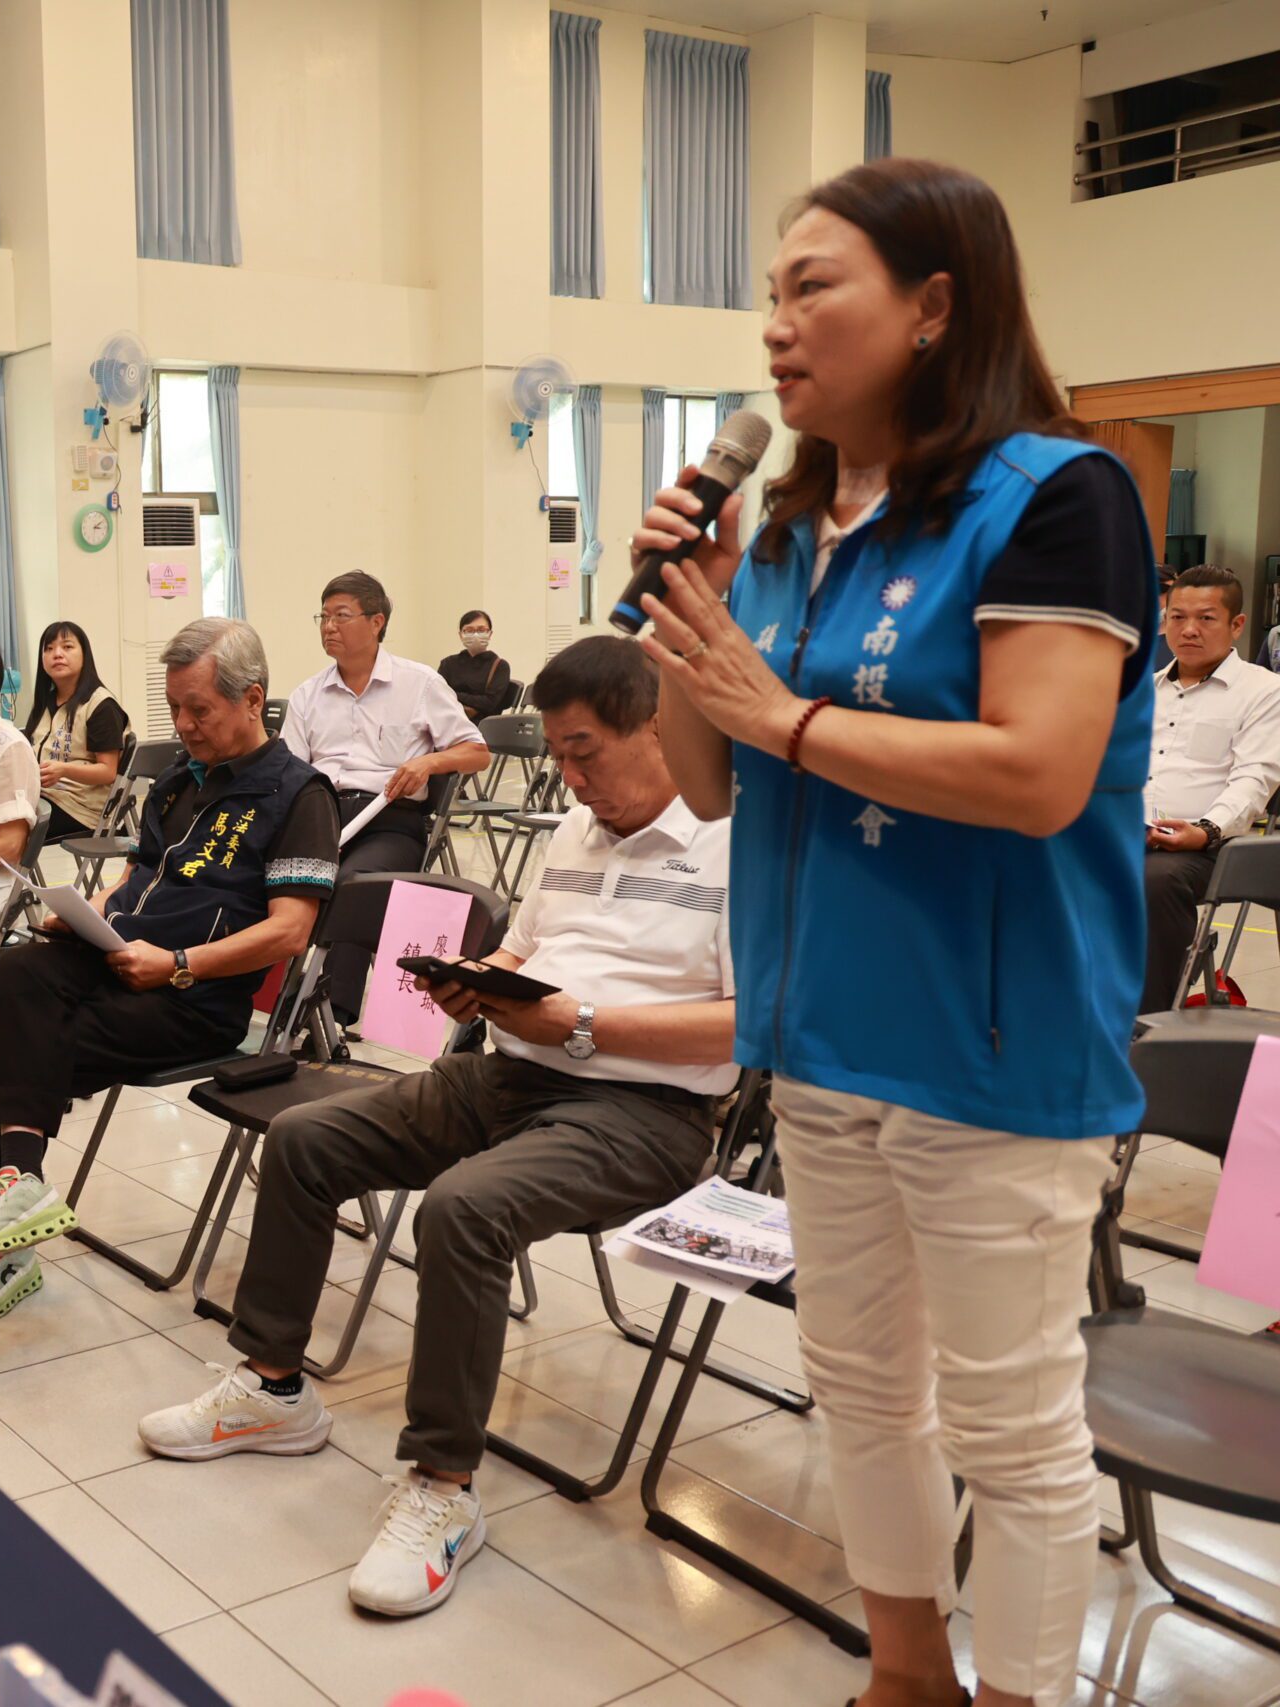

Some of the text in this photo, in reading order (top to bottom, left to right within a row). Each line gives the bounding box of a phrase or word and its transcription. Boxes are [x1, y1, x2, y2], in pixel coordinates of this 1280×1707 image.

[852, 615, 898, 848] 南投會
[178, 811, 230, 878] 馬文君
[219, 808, 256, 869] 立法委員
[661, 859, 700, 874] Titleist
[397, 942, 422, 993] 鎮長
[420, 934, 448, 1015] 廖城
